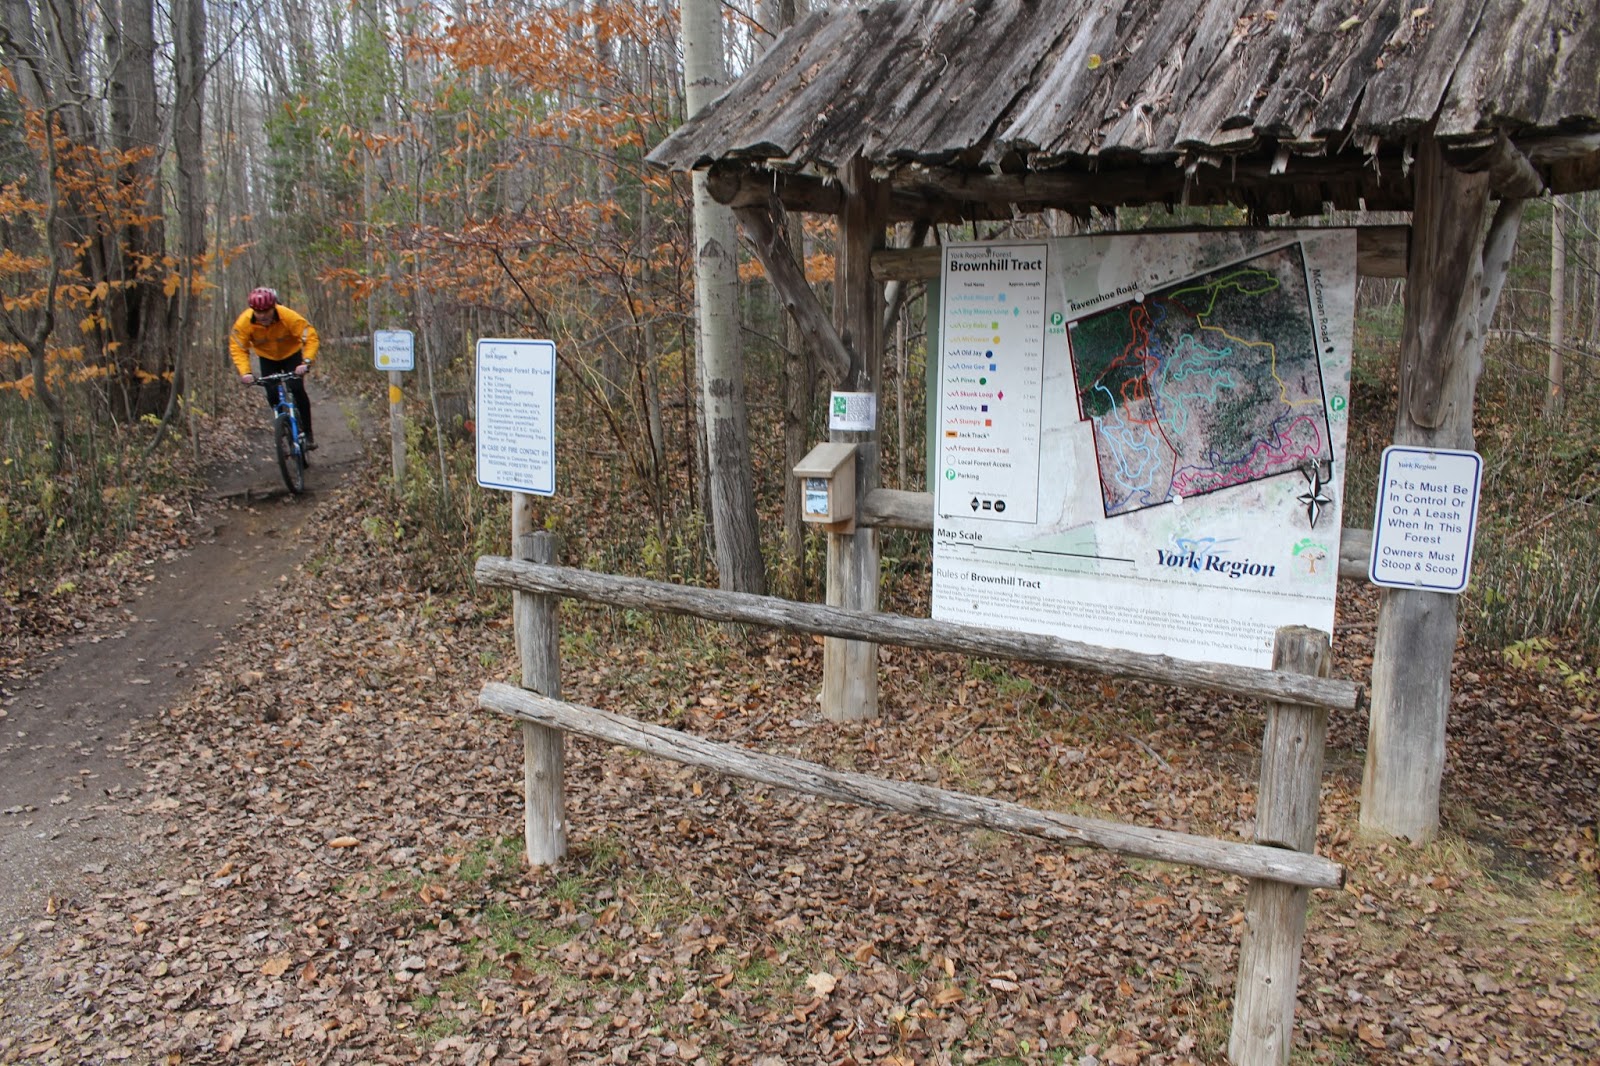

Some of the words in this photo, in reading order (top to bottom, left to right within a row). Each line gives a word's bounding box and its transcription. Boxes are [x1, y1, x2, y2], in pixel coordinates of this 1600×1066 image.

[951, 260, 1008, 271] Brownhill
[1011, 260, 1042, 270] Tract
[1071, 291, 1115, 311] Ravenshoe
[1116, 282, 1138, 295] Road
[1312, 269, 1325, 316] McCowan
[1320, 318, 1331, 343] Road
[979, 391, 993, 399] Loop
[520, 448, 540, 456] CONTACT
[993, 460, 1011, 468] Access
[1312, 458, 1320, 468] N
[1414, 463, 1436, 471] Region
[1420, 482, 1448, 493] Must
[1453, 484, 1468, 495] Be
[1390, 493, 1399, 501] In
[1405, 494, 1446, 506] Control
[1452, 498, 1465, 507] Or
[1393, 506, 1408, 515] On
[1413, 509, 1420, 517] A
[1426, 509, 1460, 520] Leash
[1388, 518, 1419, 529] When
[1424, 522, 1434, 530] In
[1439, 522, 1462, 533] This
[938, 528, 956, 538] Map
[960, 530, 982, 541] Scale
[1404, 532, 1441, 544] Forest
[1383, 546, 1423, 558] Owners
[1428, 551, 1455, 561] Must
[1157, 549, 1201, 569] York
[1205, 555, 1276, 578] Region
[1381, 559, 1411, 571] Stoop
[1414, 562, 1421, 571] &
[1425, 563, 1458, 575] Scoop
[936, 568, 958, 579] Rules
[961, 572, 969, 580] of
[971, 572, 1015, 586] Brownhill
[1017, 578, 1041, 589] Tract
